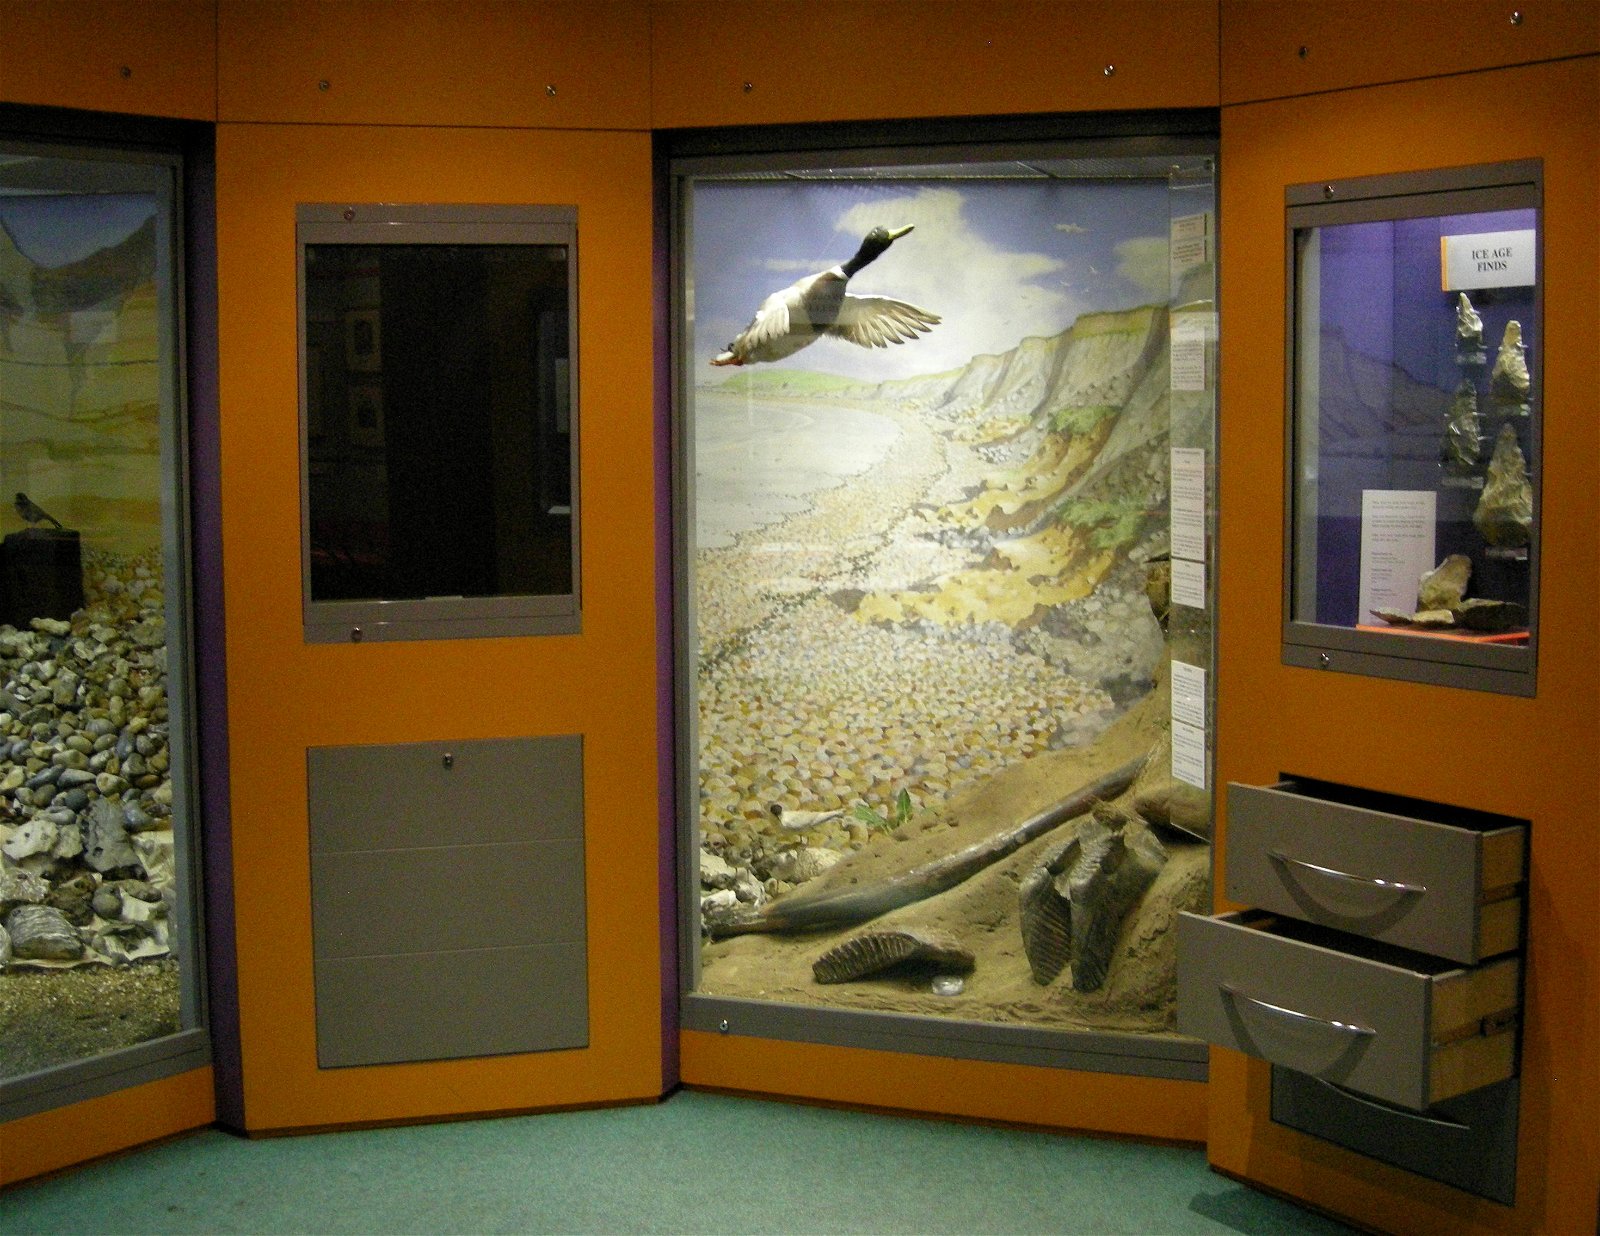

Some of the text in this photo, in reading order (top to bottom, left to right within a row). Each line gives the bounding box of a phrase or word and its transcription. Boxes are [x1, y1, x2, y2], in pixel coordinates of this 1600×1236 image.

[1472, 247, 1512, 260] ICE AGE
[1477, 261, 1507, 272] FINDS
